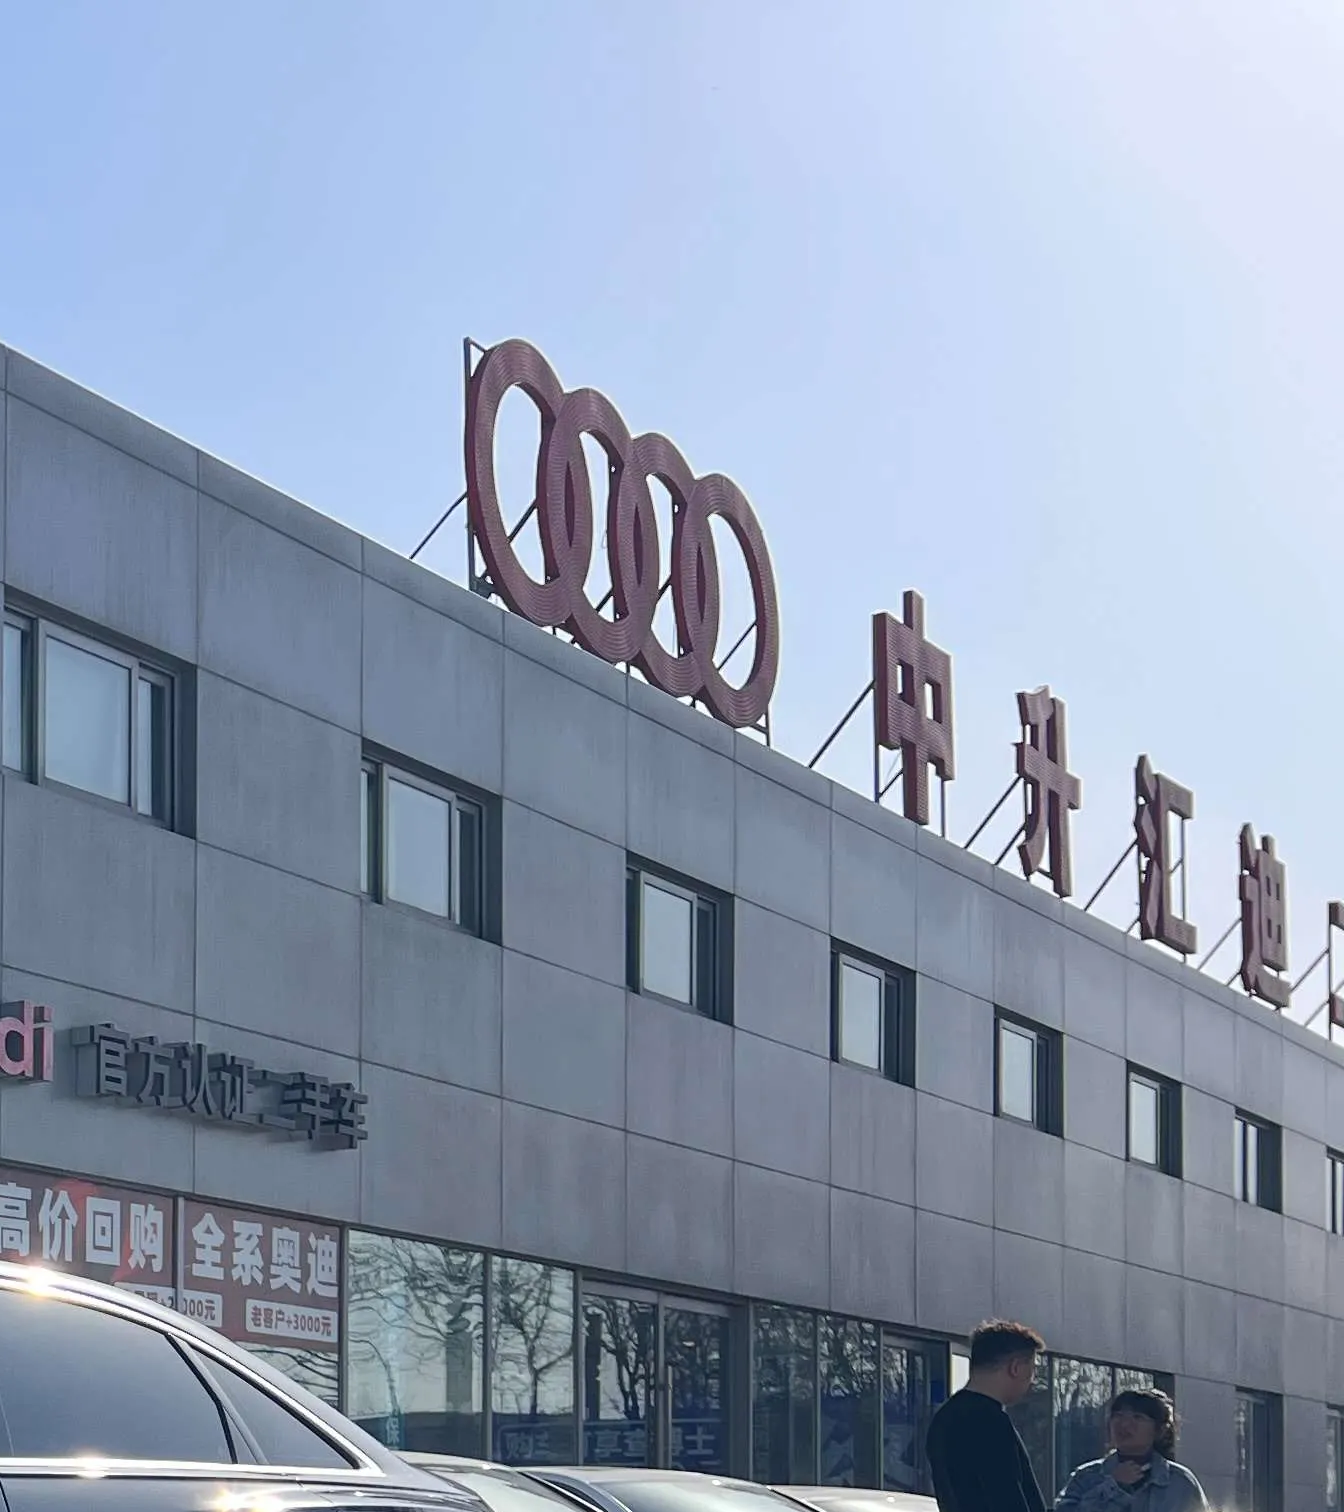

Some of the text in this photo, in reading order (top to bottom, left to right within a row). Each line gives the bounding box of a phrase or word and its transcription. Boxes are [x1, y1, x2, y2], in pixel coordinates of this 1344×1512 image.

[871, 588, 1344, 1028] 中升汇迪
[78, 1023, 368, 1149] 官方认证二手车
[191, 1212, 339, 1298] 全系奥迪
